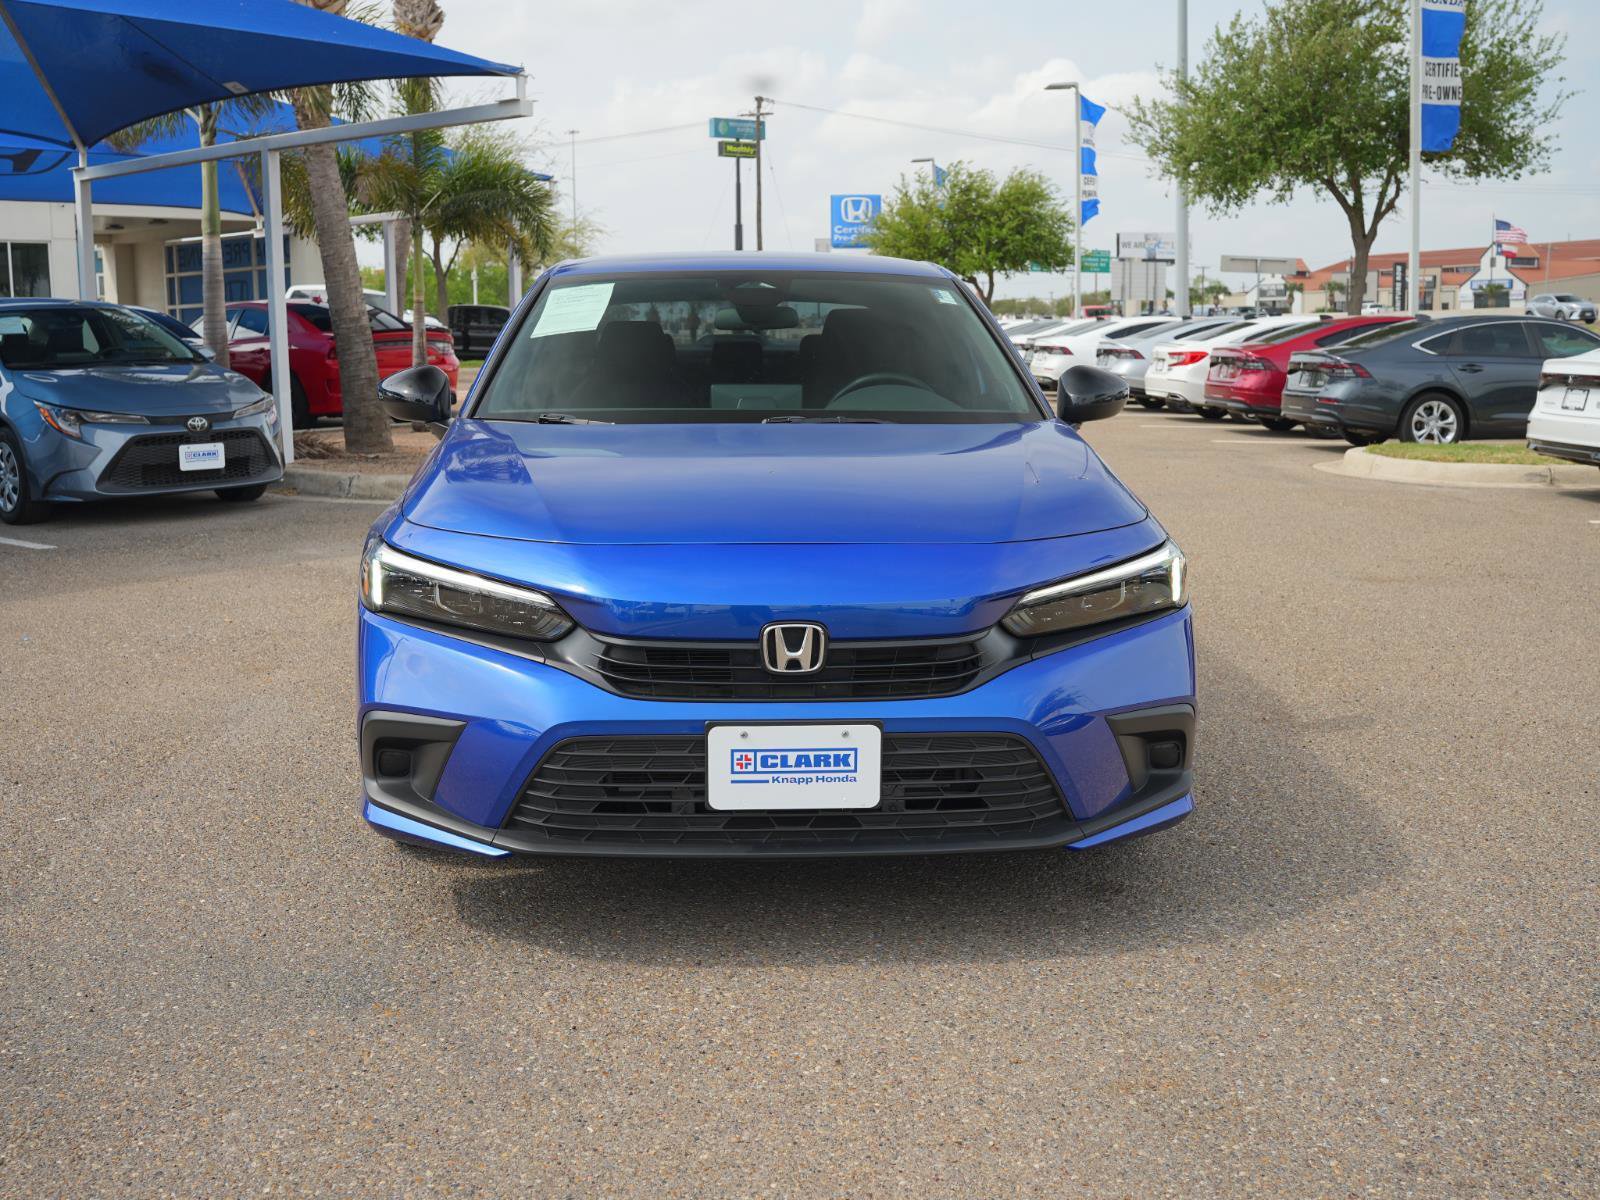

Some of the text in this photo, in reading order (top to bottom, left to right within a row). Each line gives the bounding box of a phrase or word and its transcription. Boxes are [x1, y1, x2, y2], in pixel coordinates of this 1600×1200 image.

[760, 753, 851, 769] CLARK
[771, 774, 857, 785] Knapp Honda
